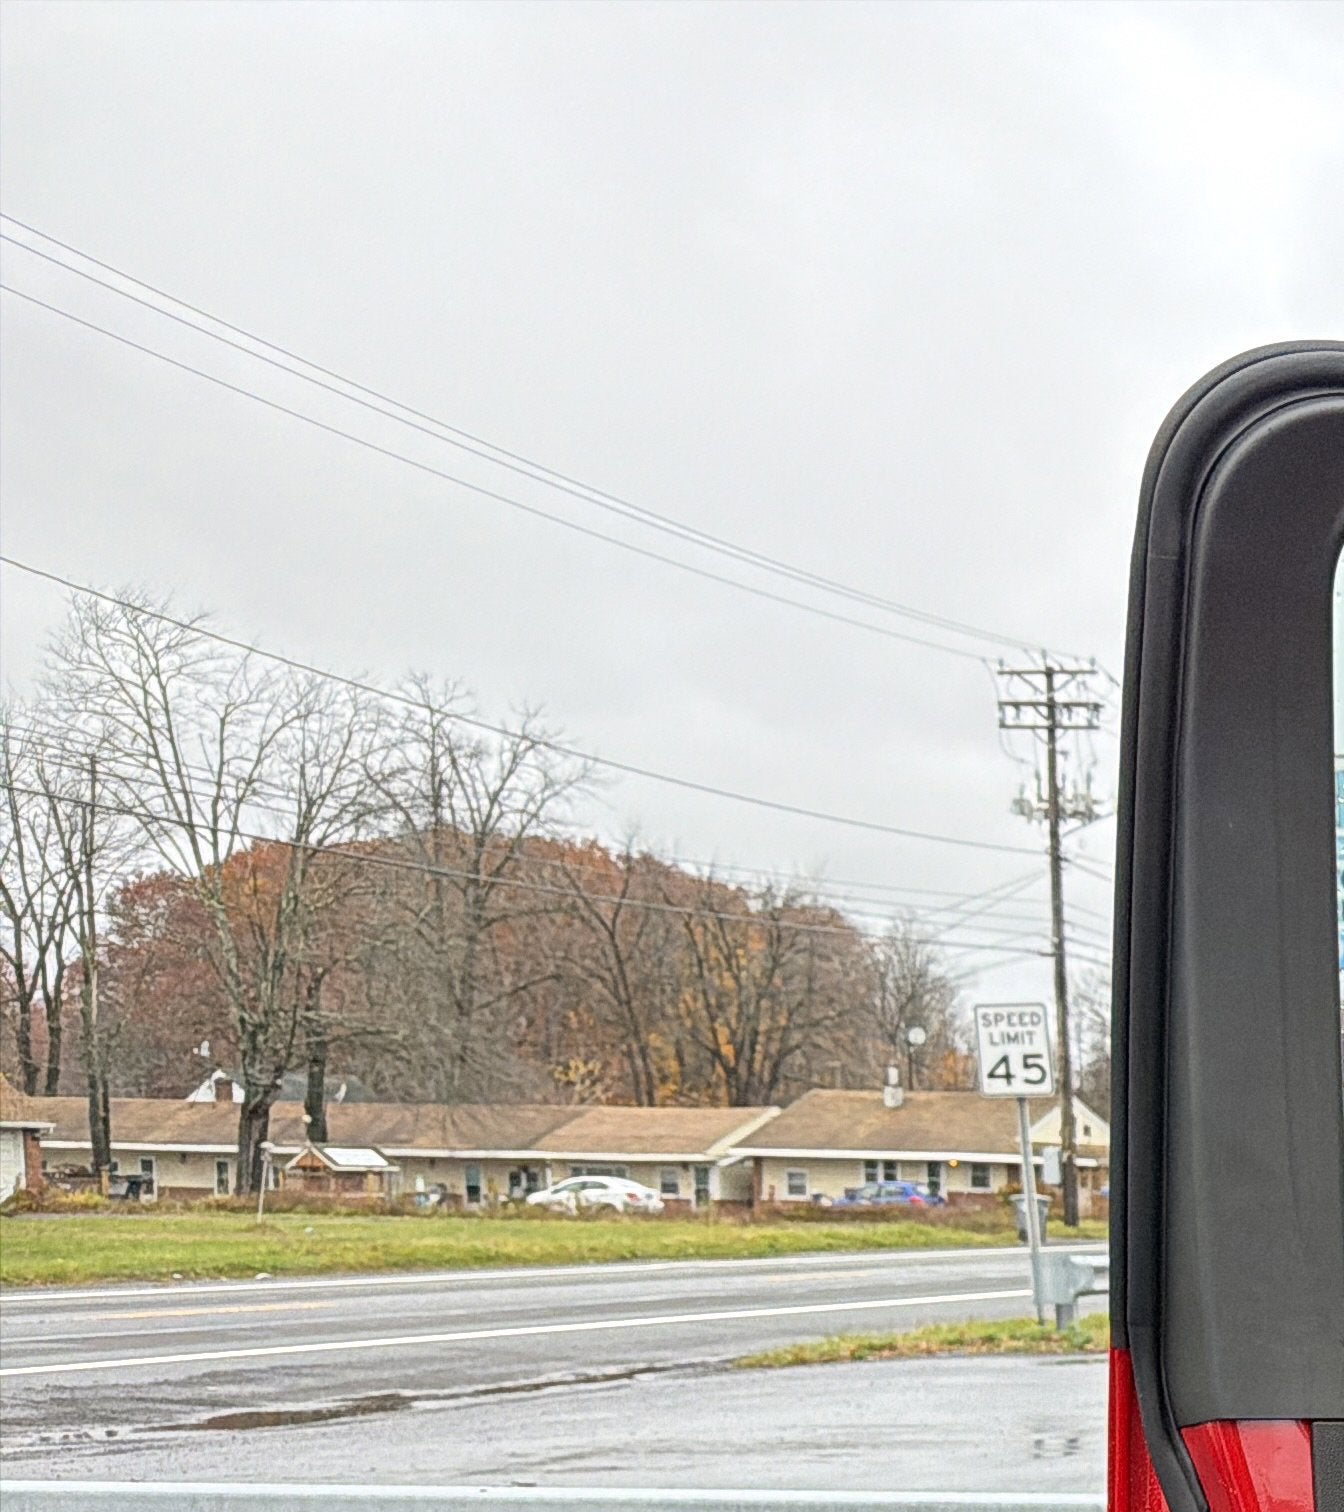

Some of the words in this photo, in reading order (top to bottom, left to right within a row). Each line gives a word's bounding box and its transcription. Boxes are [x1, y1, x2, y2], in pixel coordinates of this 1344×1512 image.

[981, 1012, 1042, 1027] SPEED
[989, 1030, 1035, 1046] LIMIT
[987, 1054, 1047, 1085] 45
